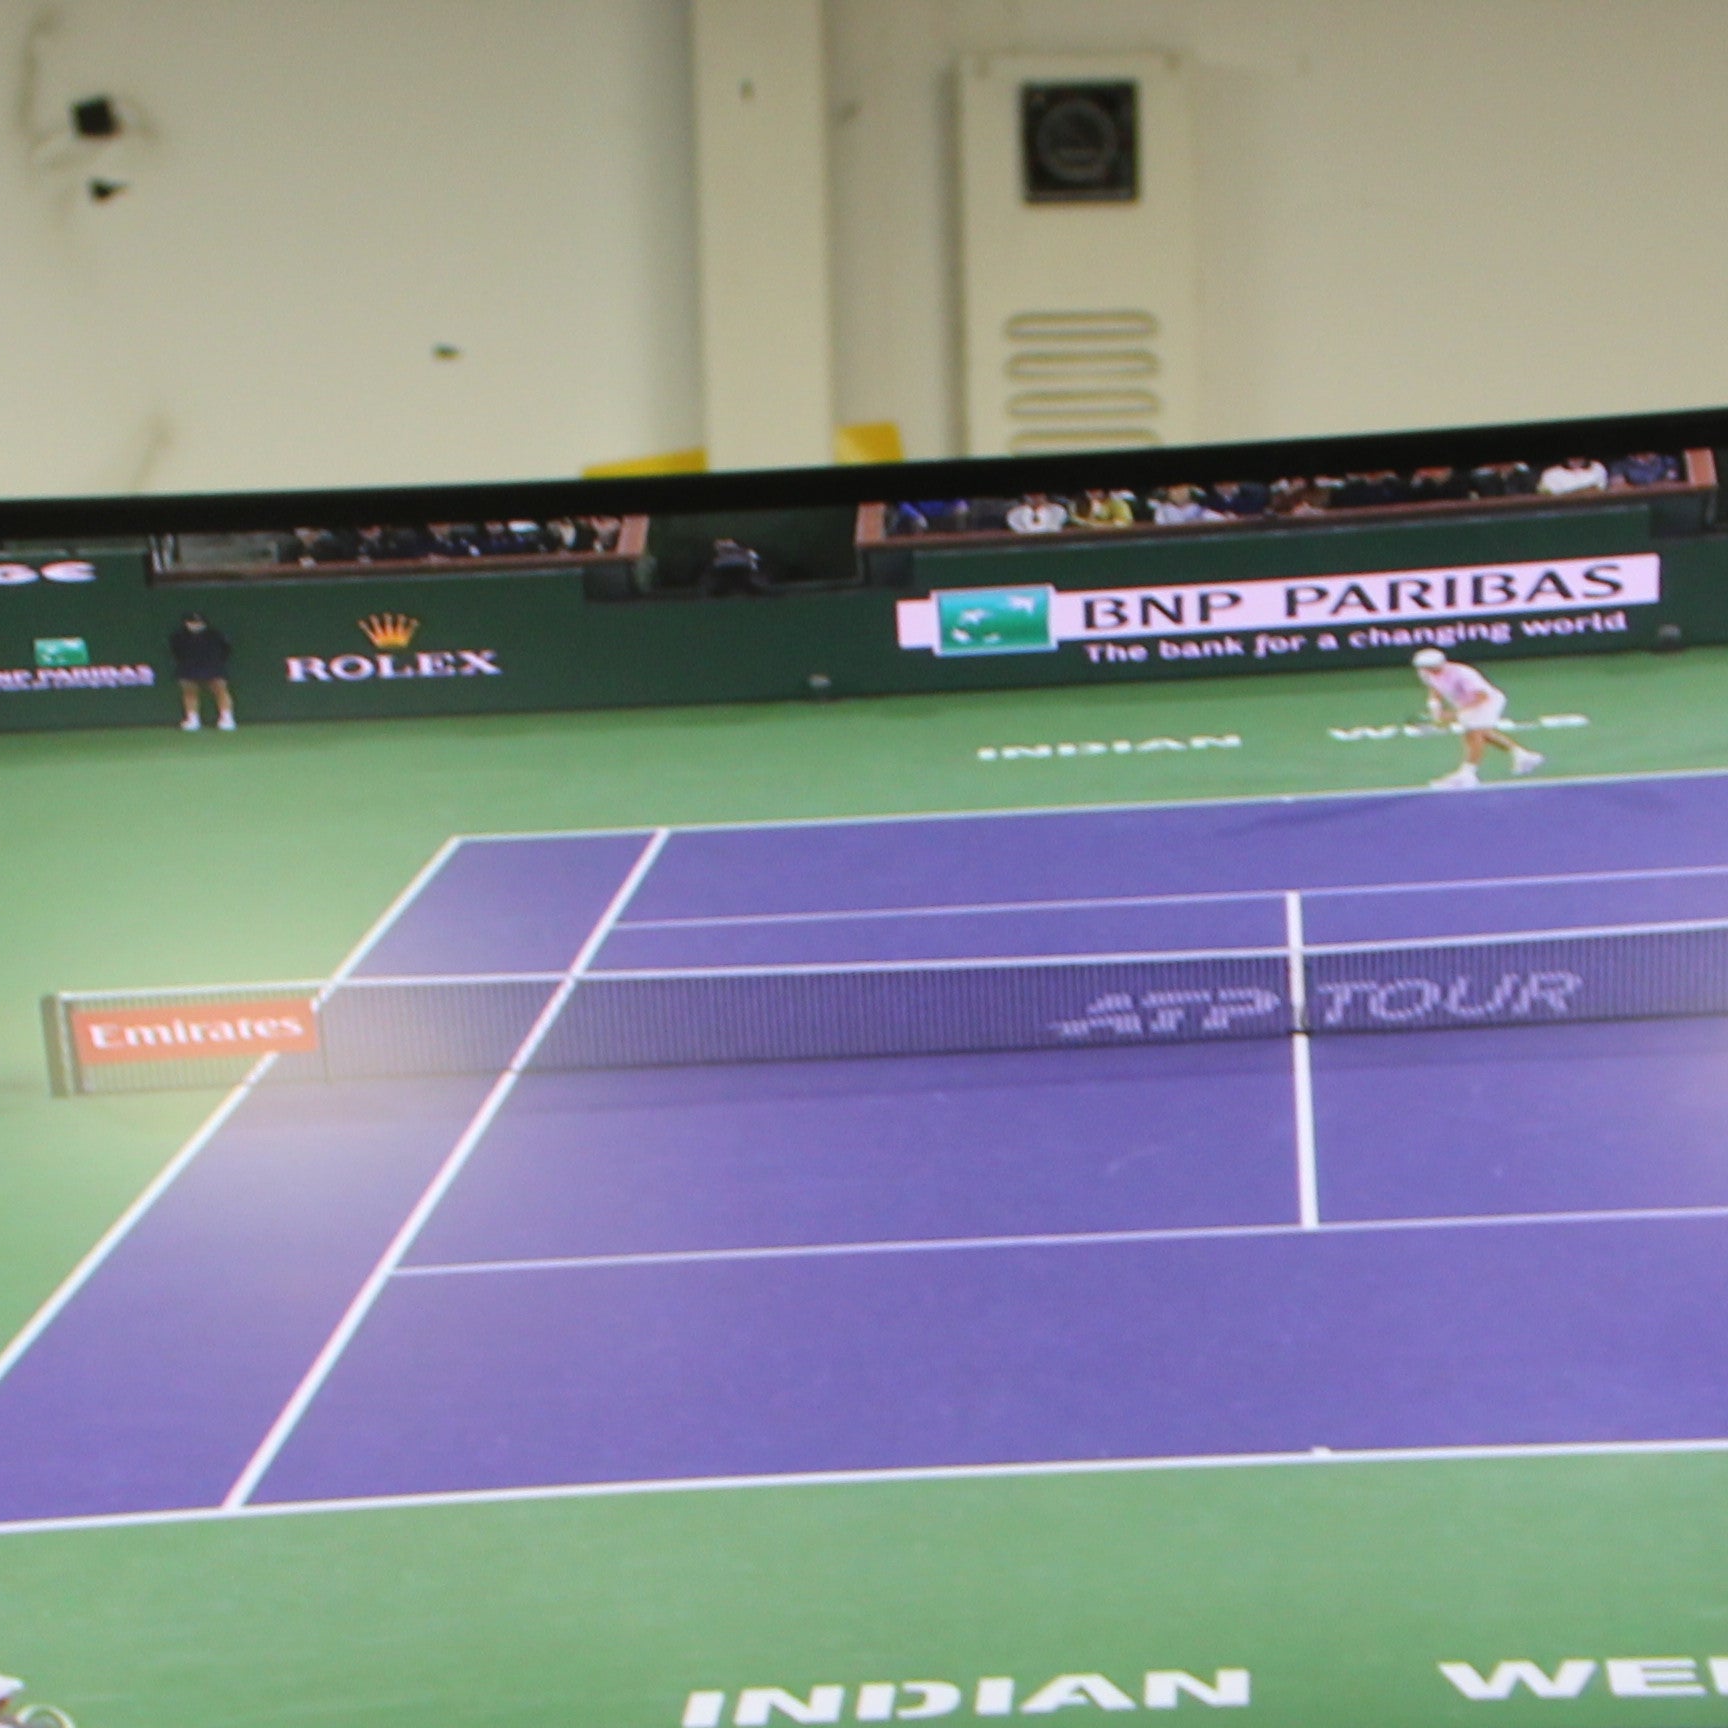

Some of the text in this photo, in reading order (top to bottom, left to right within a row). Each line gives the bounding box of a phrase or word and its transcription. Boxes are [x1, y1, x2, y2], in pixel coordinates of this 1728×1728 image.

[1084, 565, 1624, 630] BNP PARIBAS
[1084, 611, 1628, 664] The bank for a changing world
[285, 650, 502, 682] ROLEX
[978, 713, 1590, 762] INDIAN WELS
[1047, 969, 1584, 1042] ATP TOUR
[88, 1016, 304, 1050] Emirates
